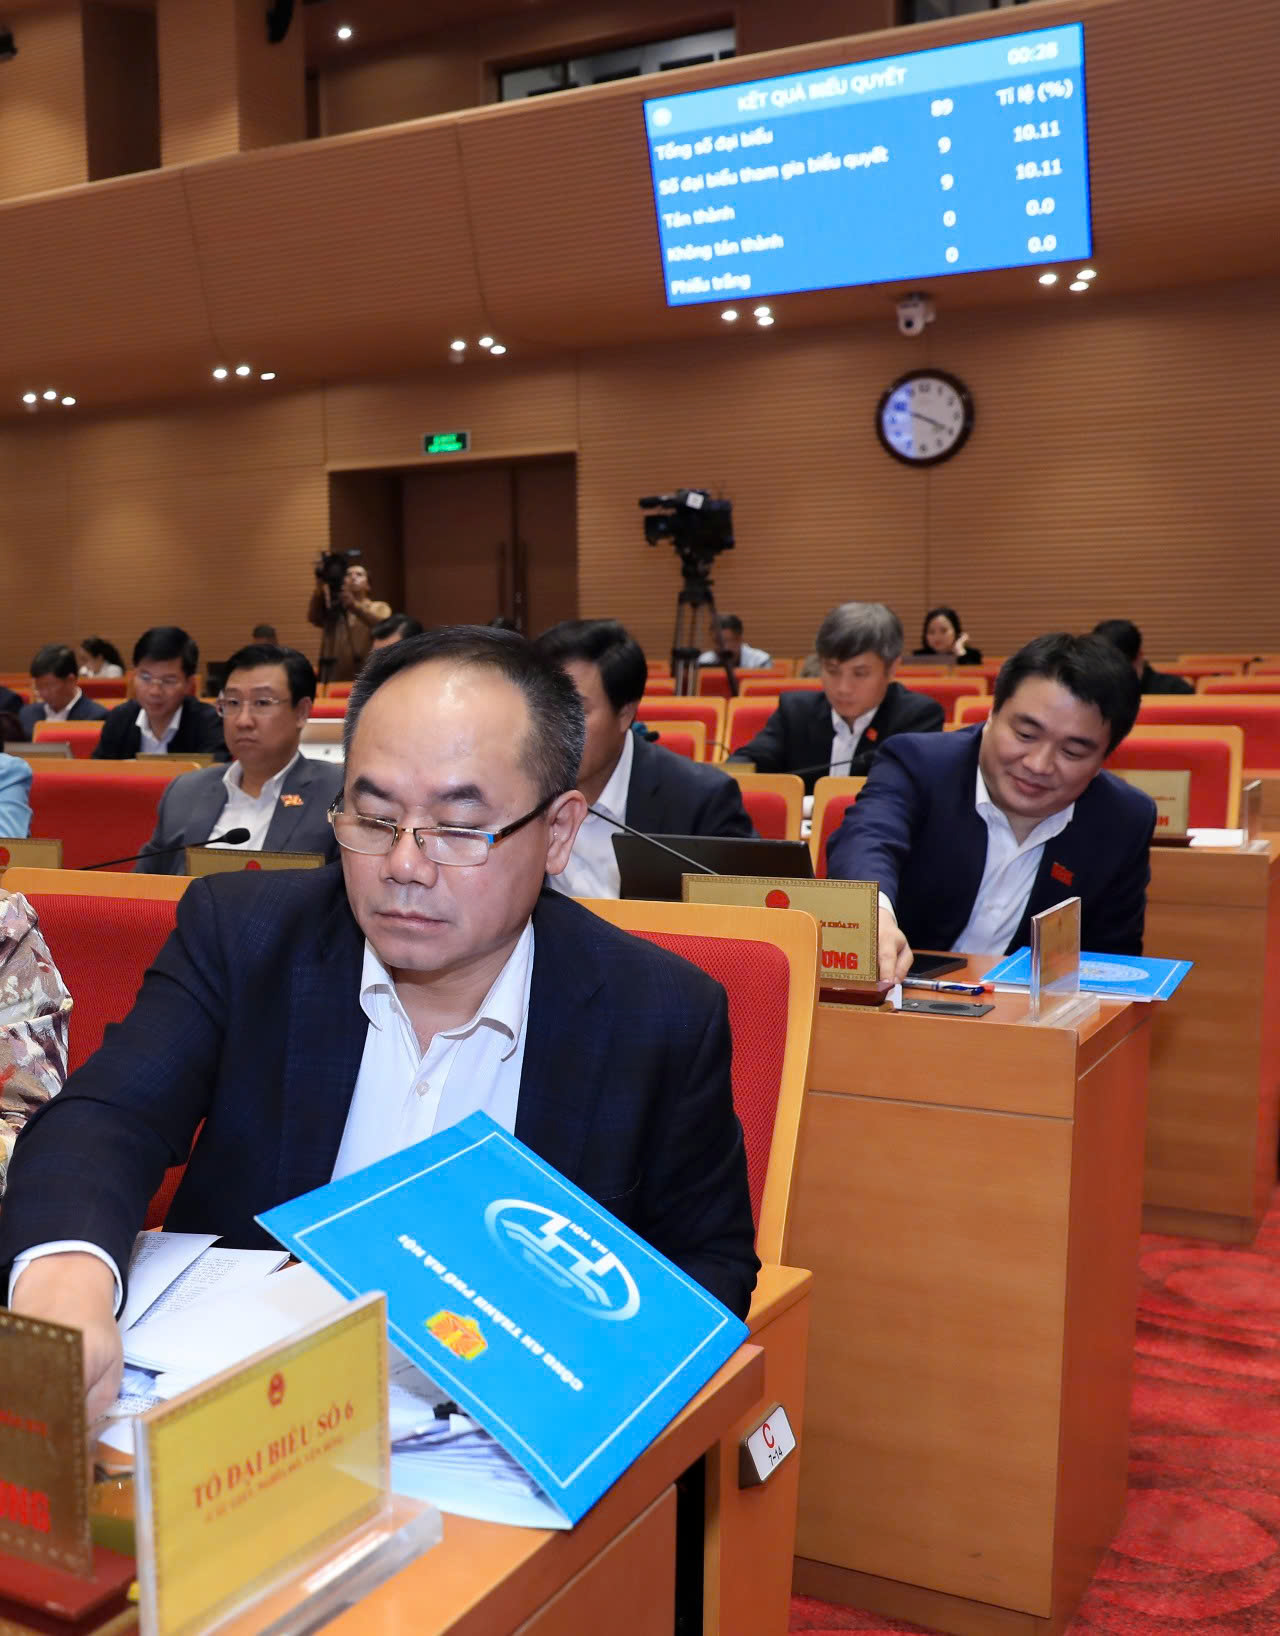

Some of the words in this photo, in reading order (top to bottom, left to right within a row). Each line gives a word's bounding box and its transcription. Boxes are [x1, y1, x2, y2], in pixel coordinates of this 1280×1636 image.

[1013, 120, 1060, 143] 10.11
[938, 136, 952, 154] 9
[1015, 157, 1063, 181] 10.11
[1025, 197, 1056, 217] 0.0
[942, 210, 957, 228] 0
[1027, 234, 1057, 254] 0.0
[945, 246, 959, 264] 0
[473, 1295, 523, 1338] THÀNH
[520, 1335, 545, 1355] AN
[542, 1353, 584, 1391] CÔNG
[762, 1423, 775, 1449] C
[768, 1445, 783, 1466] 7-14
[227, 1449, 263, 1491] ĐẠI
